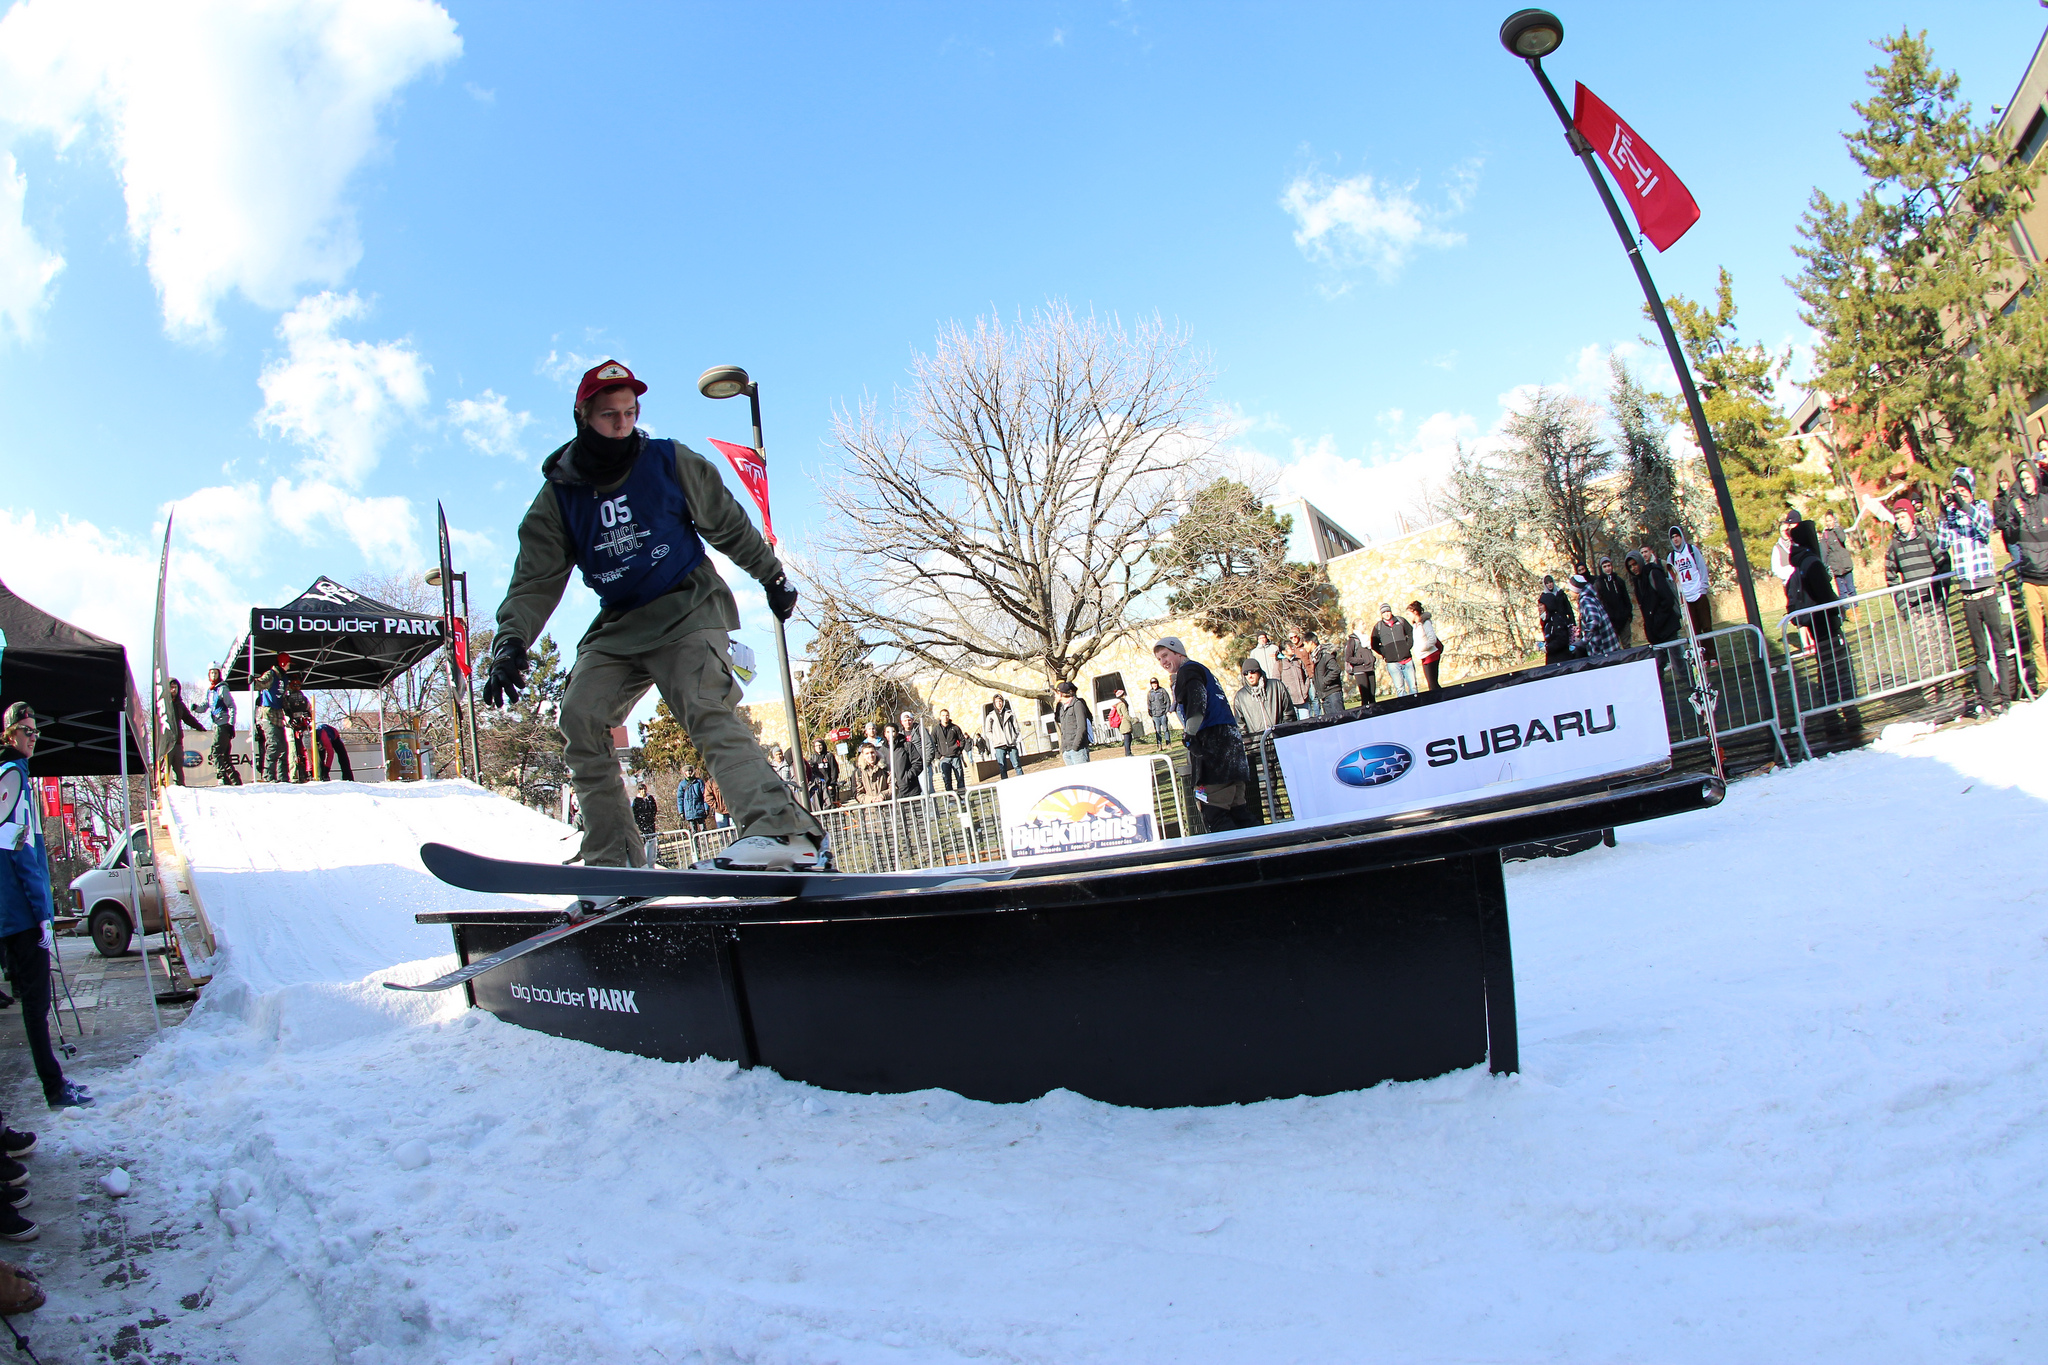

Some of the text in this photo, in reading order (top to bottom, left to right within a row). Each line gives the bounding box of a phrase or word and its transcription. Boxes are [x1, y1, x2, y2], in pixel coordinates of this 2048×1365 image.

[600, 494, 633, 528] 05
[602, 572, 623, 584] PARK
[1681, 570, 1692, 582] 14
[261, 615, 293, 634] big
[299, 616, 378, 633] boulder
[384, 618, 441, 636] PARK
[1425, 704, 1617, 768] SUBARU
[510, 982, 640, 1014] big boulder PARK
